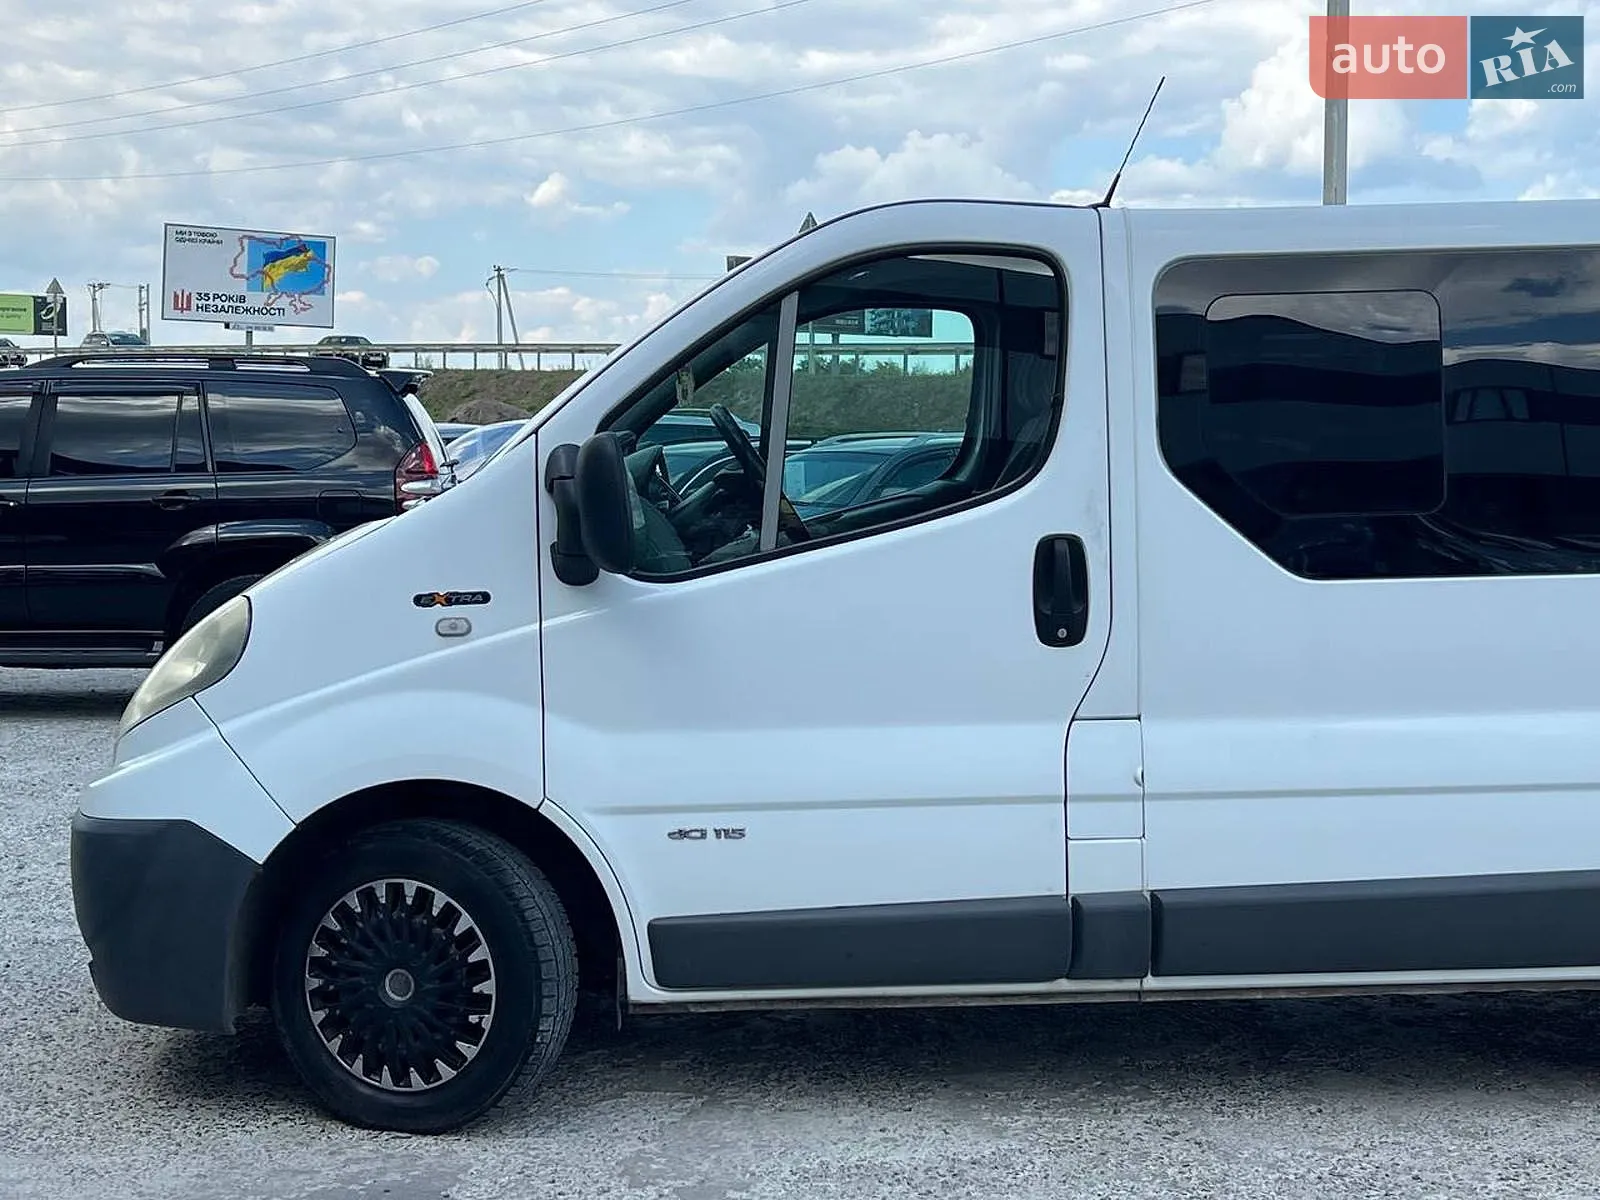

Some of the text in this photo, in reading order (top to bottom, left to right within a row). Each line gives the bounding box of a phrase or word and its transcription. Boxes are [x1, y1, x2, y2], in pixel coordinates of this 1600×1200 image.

[195, 292, 247, 304] 35 РОКІВ
[195, 303, 286, 317] НЕЗАЛЕЖНОСТІ
[420, 592, 484, 605] EXTRA
[713, 828, 746, 840] 115
